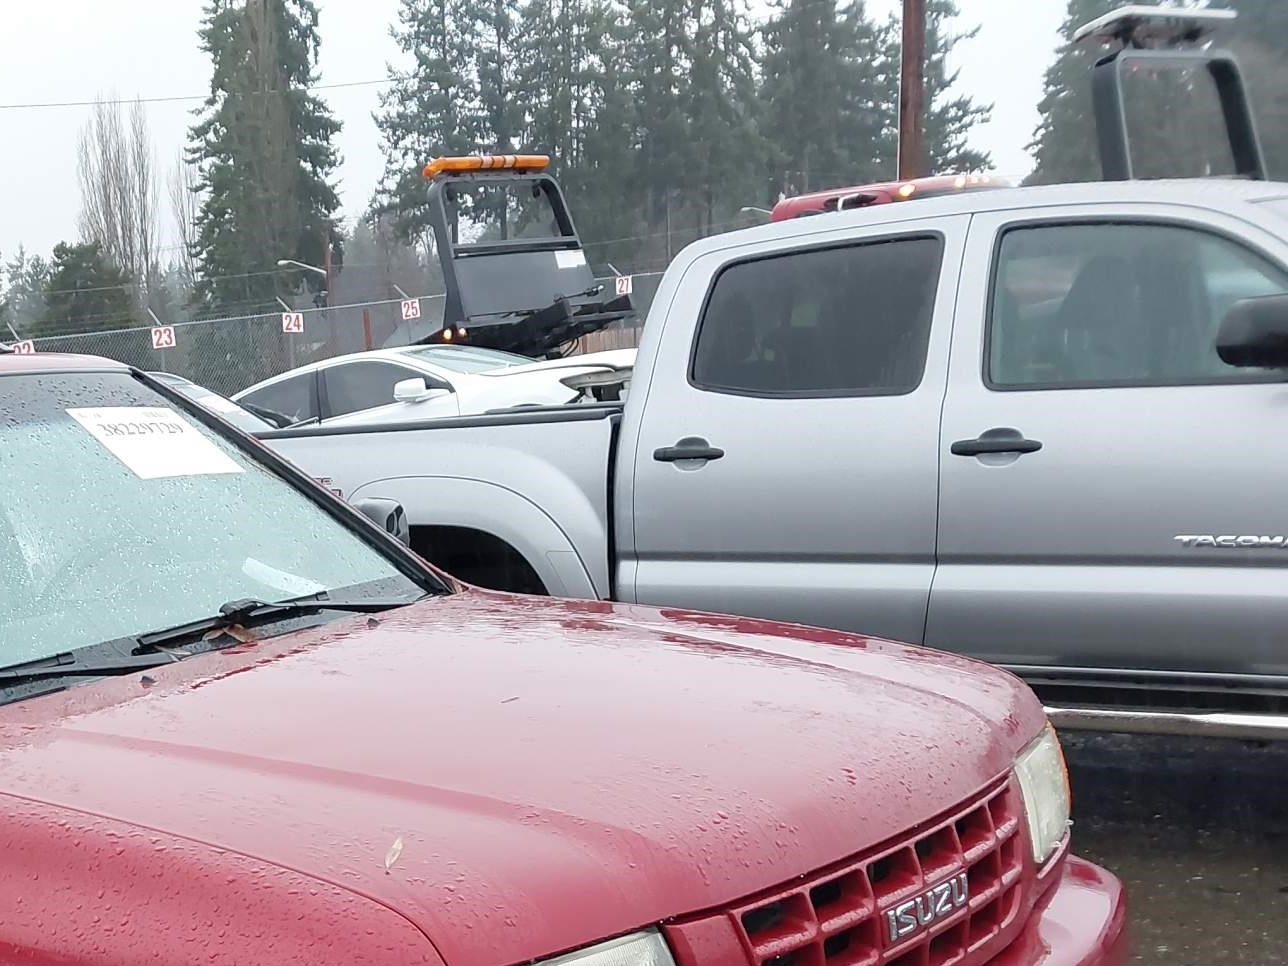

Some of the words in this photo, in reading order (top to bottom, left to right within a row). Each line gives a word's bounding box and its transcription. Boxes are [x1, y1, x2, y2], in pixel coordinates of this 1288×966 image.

[617, 278, 630, 294] 27
[403, 301, 418, 318] 25
[284, 314, 301, 331] 24
[153, 328, 174, 347] 23
[1173, 535, 1288, 548] TACOM
[886, 872, 969, 942] ISUZU
